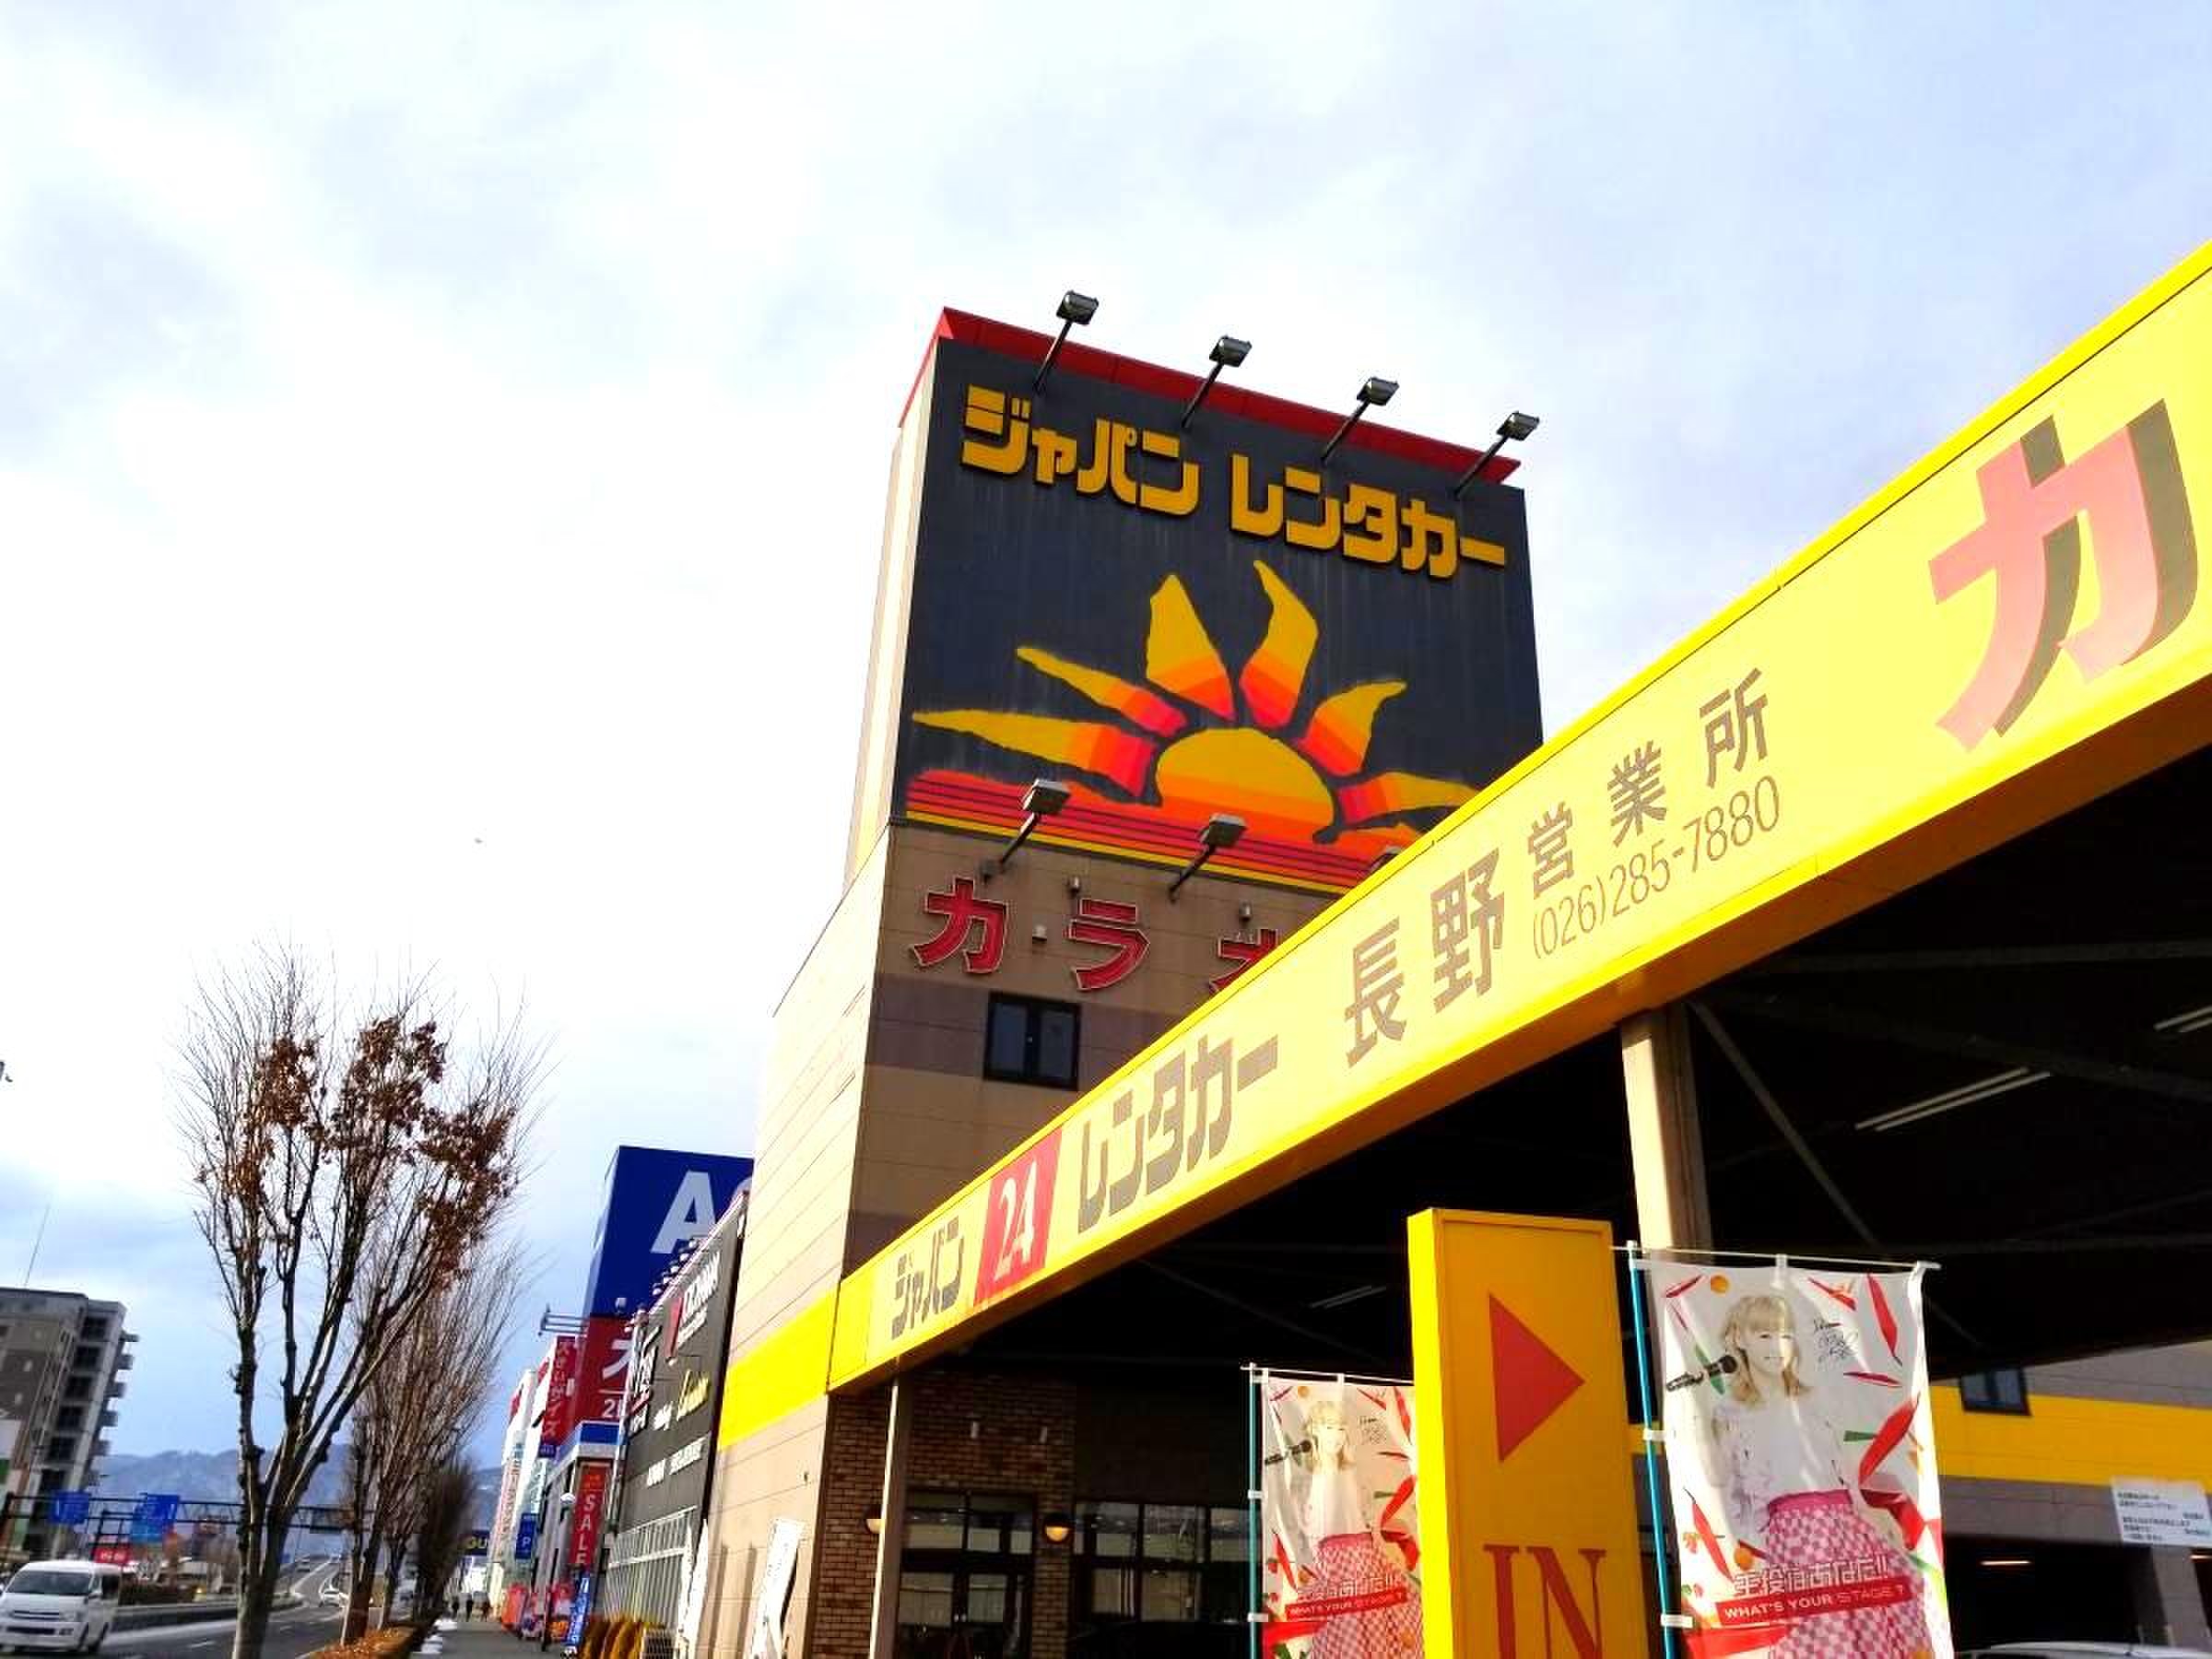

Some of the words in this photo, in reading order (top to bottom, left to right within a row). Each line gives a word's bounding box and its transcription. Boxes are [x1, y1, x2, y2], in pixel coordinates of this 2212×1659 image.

[962, 383, 1200, 517] ジャパン
[1230, 453, 1505, 579] レンタカー
[1928, 398, 2199, 754] カ
[1532, 775, 1781, 959] (026)285-7880
[891, 1215, 964, 1340] ジャパン
[994, 1155, 1038, 1282] 24
[1077, 1033, 1279, 1235] レンタカー
[1483, 1544, 1606, 1659] IN
[1724, 1600, 1784, 1620] WHAT'S
[1786, 1593, 1833, 1612] YOUR
